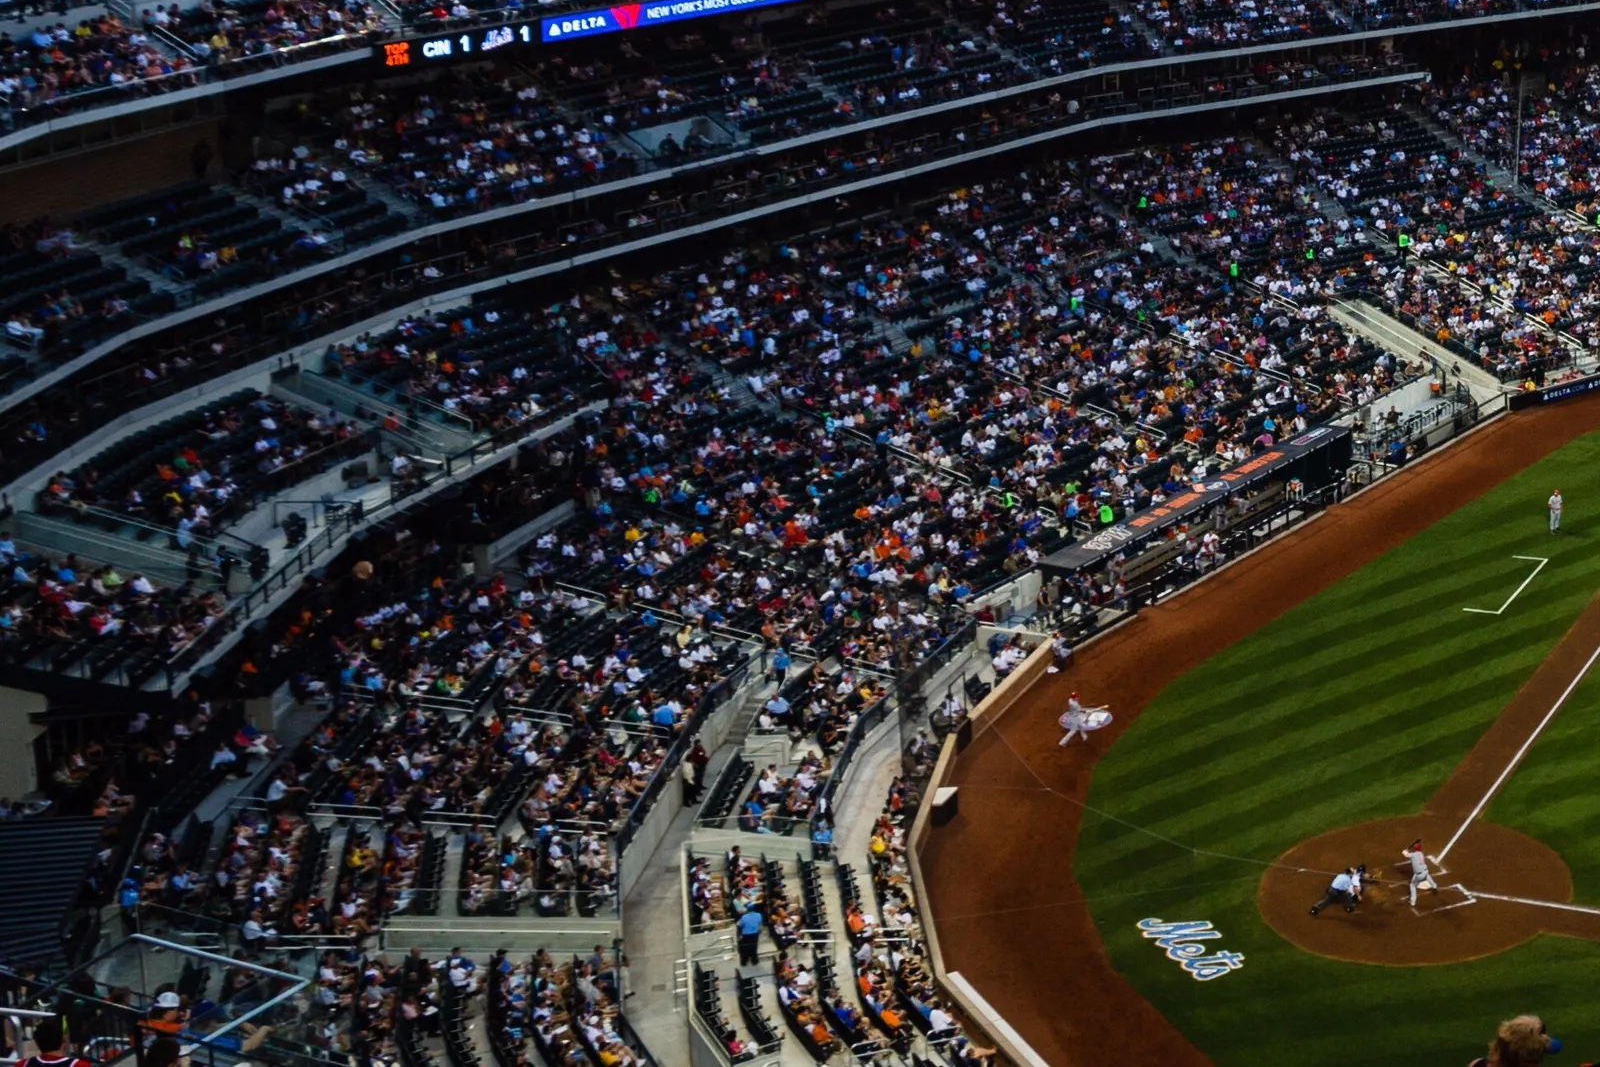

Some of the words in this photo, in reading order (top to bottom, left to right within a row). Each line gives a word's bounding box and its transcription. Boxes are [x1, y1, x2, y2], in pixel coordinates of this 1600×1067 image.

[647, 5, 670, 19] NEW
[671, 0, 701, 15] YORK'S
[562, 16, 606, 33] DELTA
[520, 25, 531, 42] 1
[384, 42, 409, 54] TOP
[423, 40, 451, 57] CIN
[460, 35, 471, 51] 1
[386, 53, 410, 66] 4TH
[1136, 917, 1245, 981] Mets
